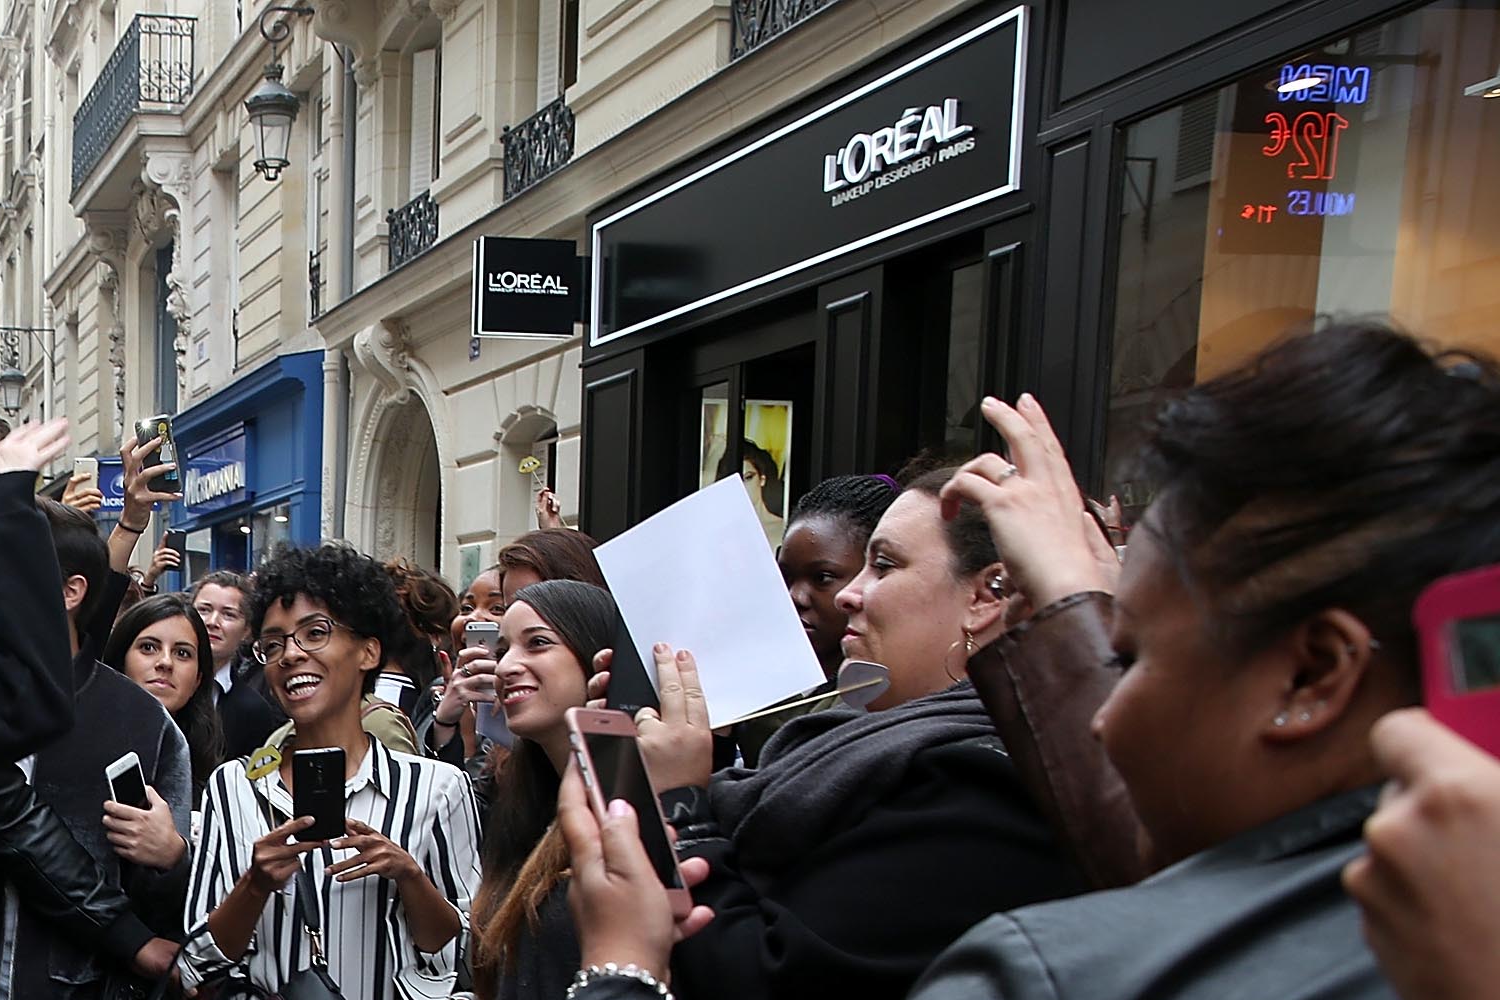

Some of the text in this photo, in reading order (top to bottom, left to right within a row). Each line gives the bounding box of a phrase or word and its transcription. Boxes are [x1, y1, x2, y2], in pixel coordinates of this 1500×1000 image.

[823, 97, 974, 193] L'ORÉAL
[831, 179, 874, 207] MAKEUP
[875, 155, 932, 189] DESIGNER
[938, 137, 976, 163] PARIS
[488, 271, 569, 290] L'ORÉAL
[184, 461, 246, 507] MICROMANIA
